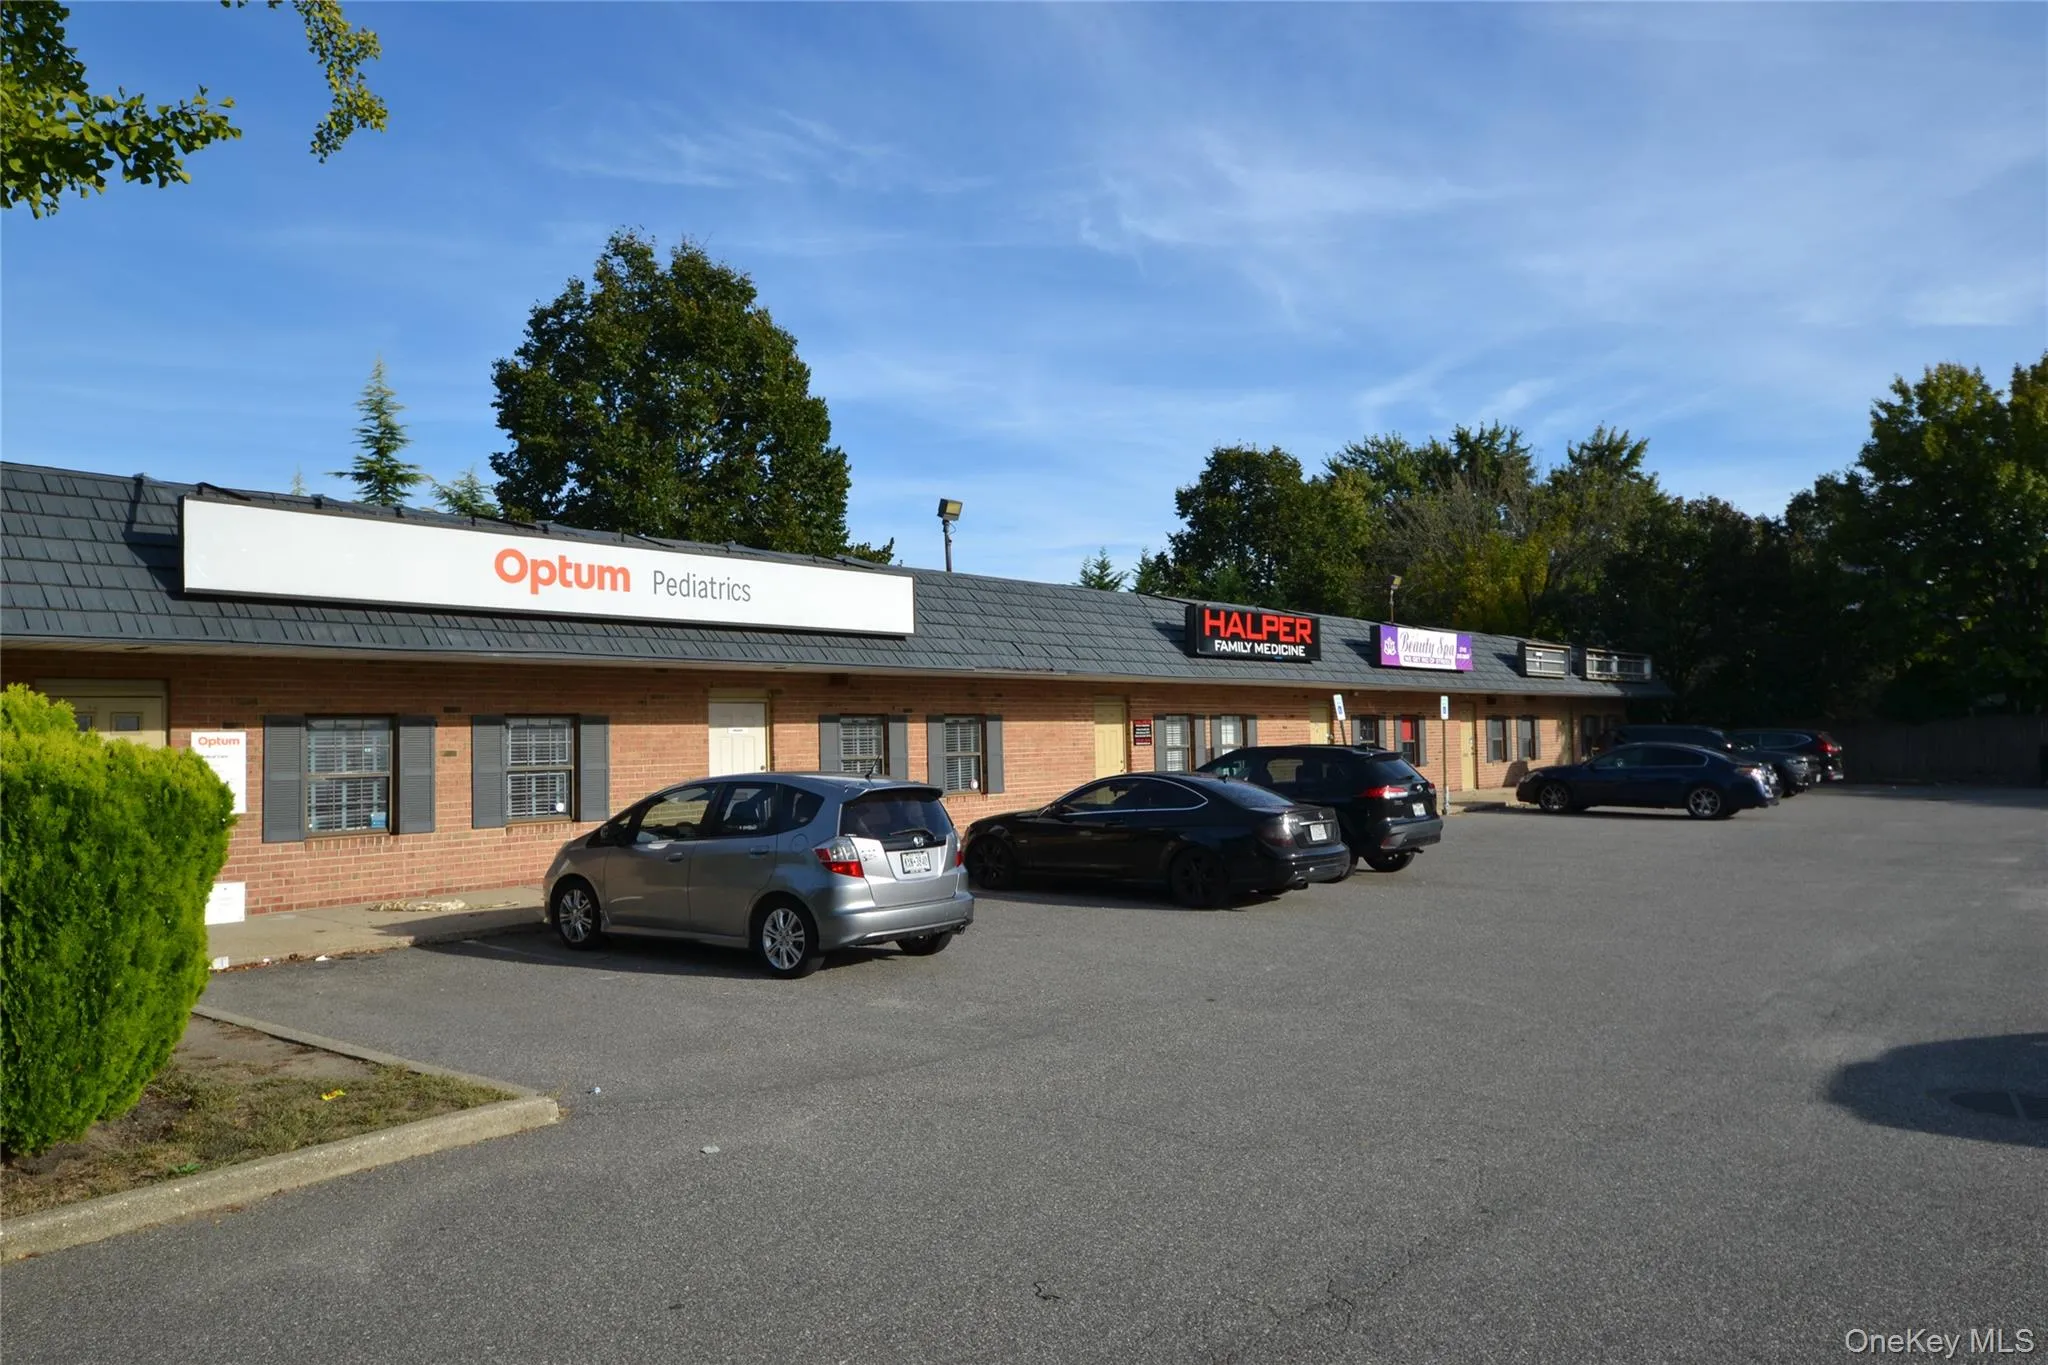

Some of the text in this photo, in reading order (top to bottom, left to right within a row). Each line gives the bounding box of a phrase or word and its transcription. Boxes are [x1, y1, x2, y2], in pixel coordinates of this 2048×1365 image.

[494, 548, 751, 602] Optum Pediatrics
[1204, 608, 1313, 644] HALPER
[1214, 639, 1306, 657] FAMILY MEDICINE
[1400, 631, 1435, 658] Beauty
[1437, 637, 1455, 659] Spa
[198, 736, 240, 748] Optum
